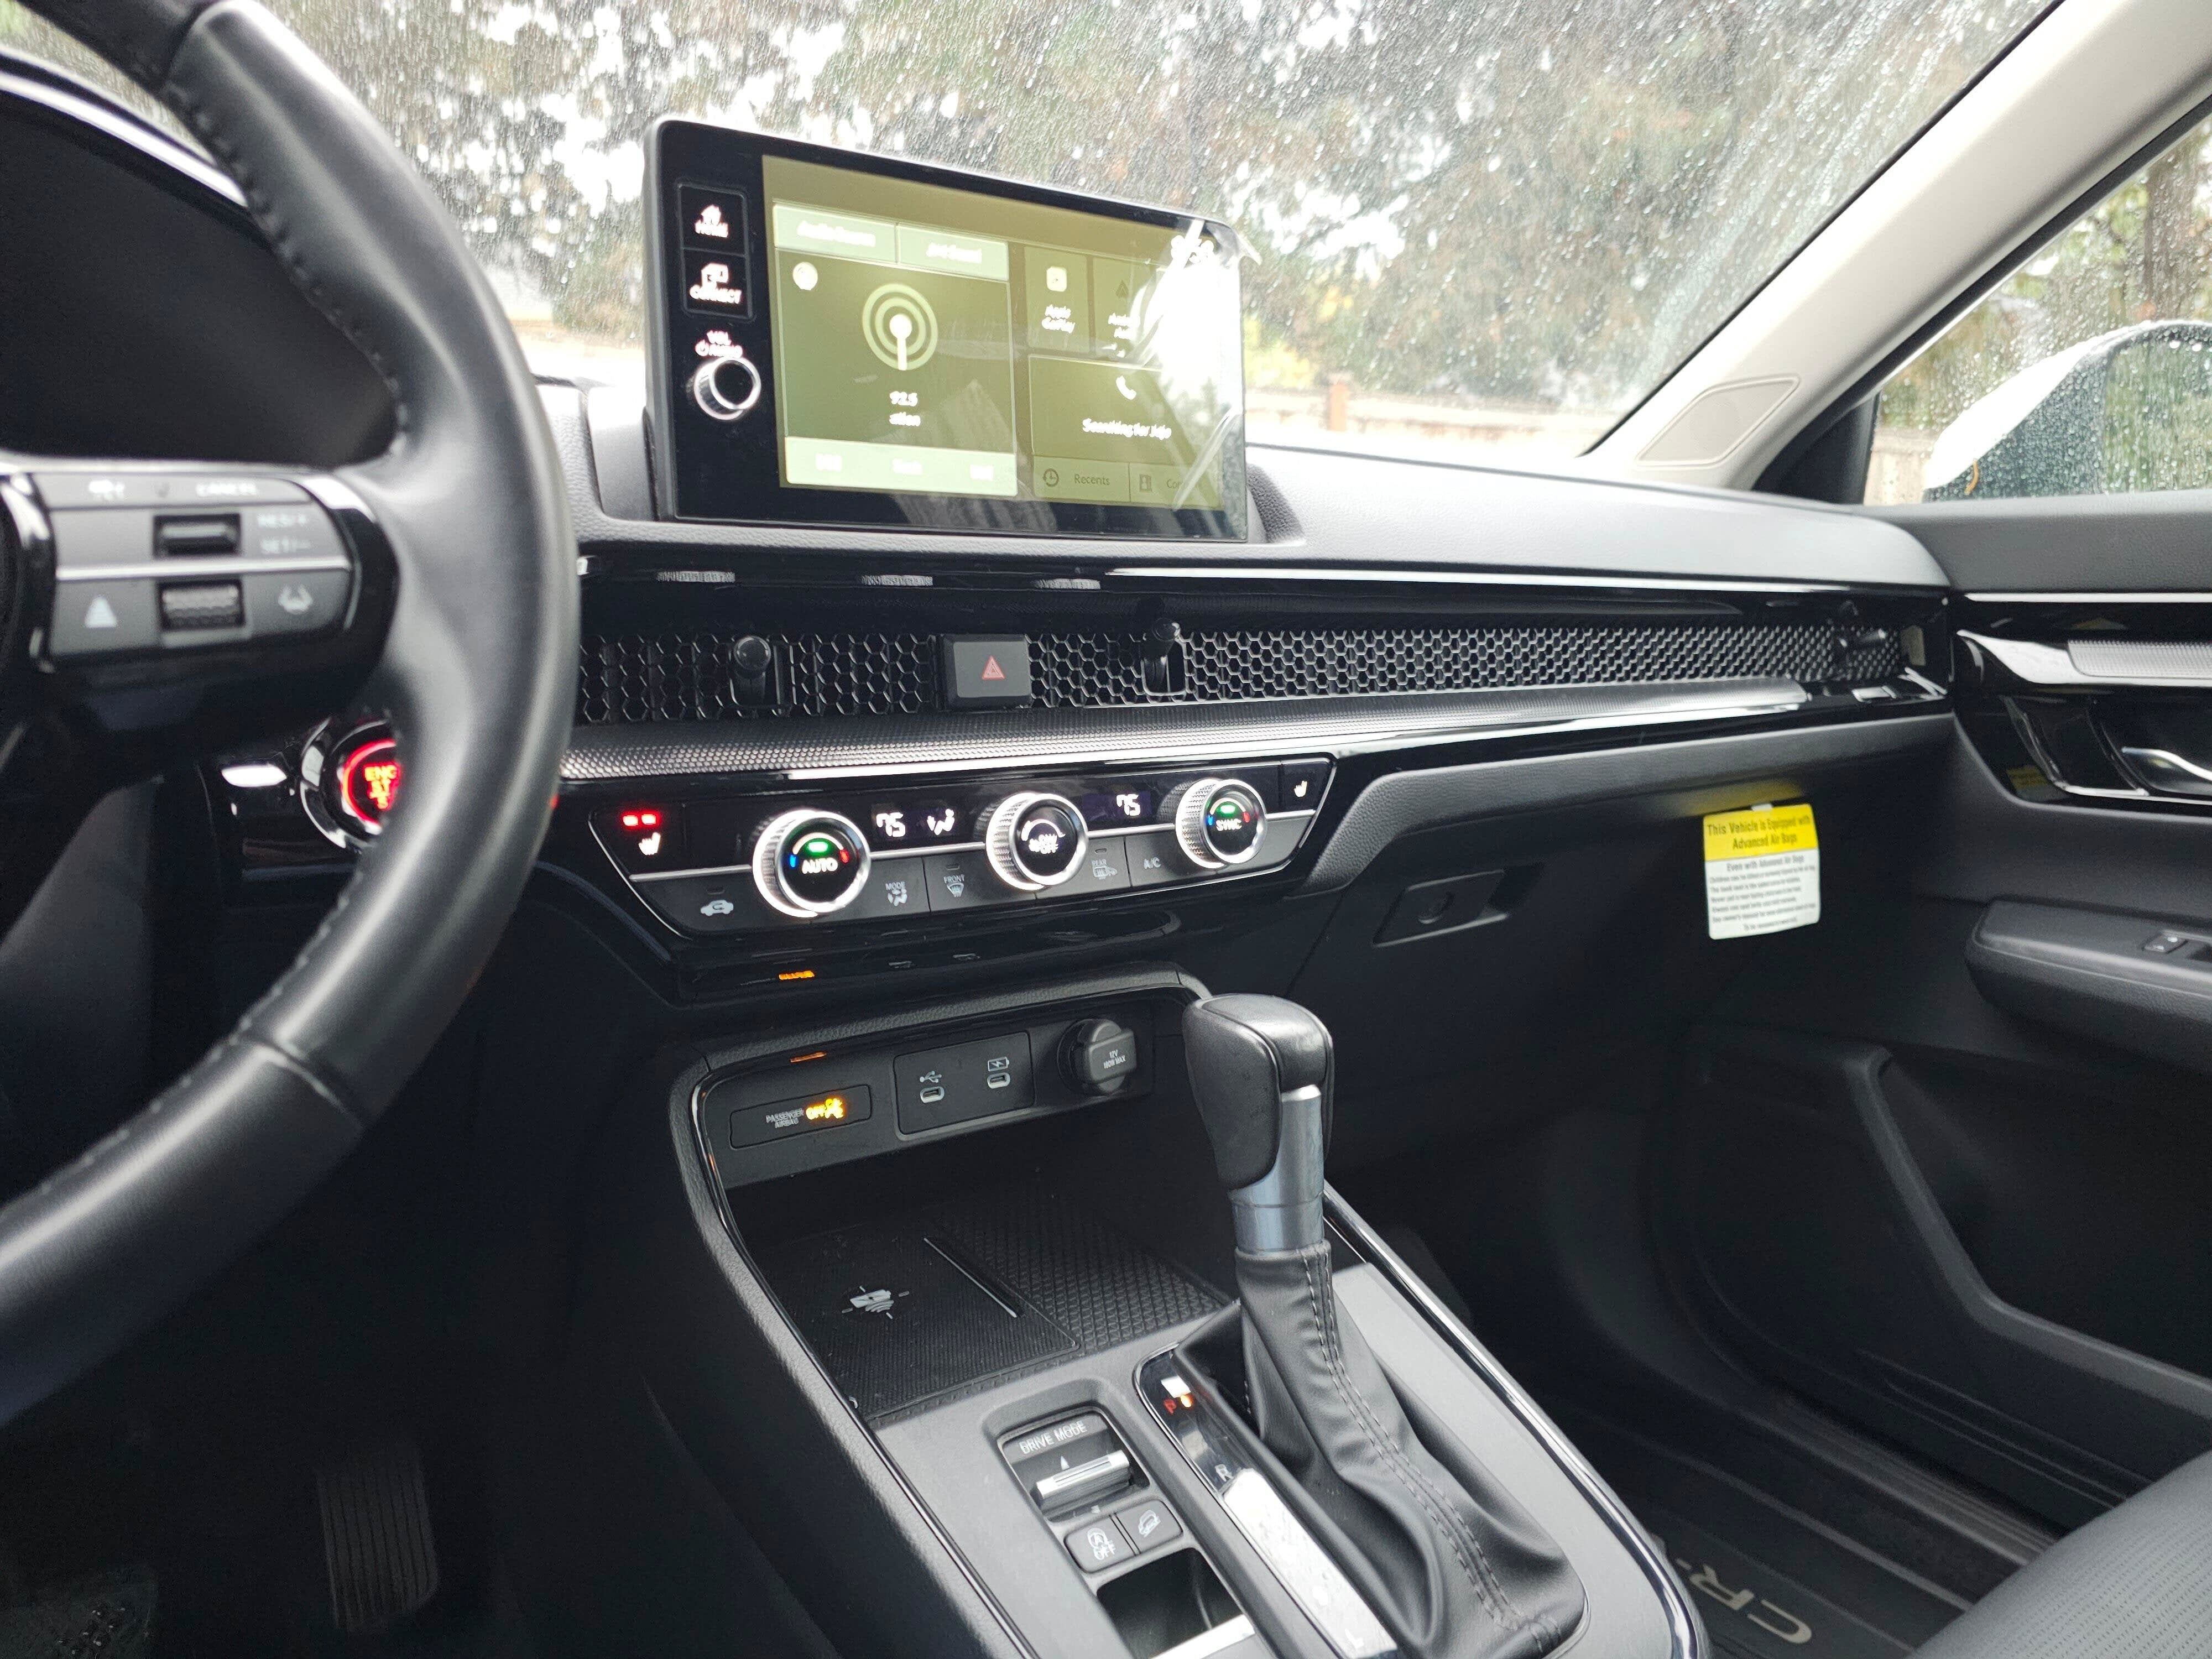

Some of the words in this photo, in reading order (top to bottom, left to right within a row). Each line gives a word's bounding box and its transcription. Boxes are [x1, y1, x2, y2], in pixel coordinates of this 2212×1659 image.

[1074, 473, 1110, 486] Recents
[1707, 823, 1726, 836] This
[1729, 820, 1759, 833] Vehicle
[1732, 836, 1769, 850] Advanced
[802, 857, 838, 874] AUTO
[885, 881, 906, 891] MODE
[943, 874, 965, 884] FRONT
[1019, 1433, 1054, 1454] DRIVE
[1053, 1420, 1087, 1442] MODE
